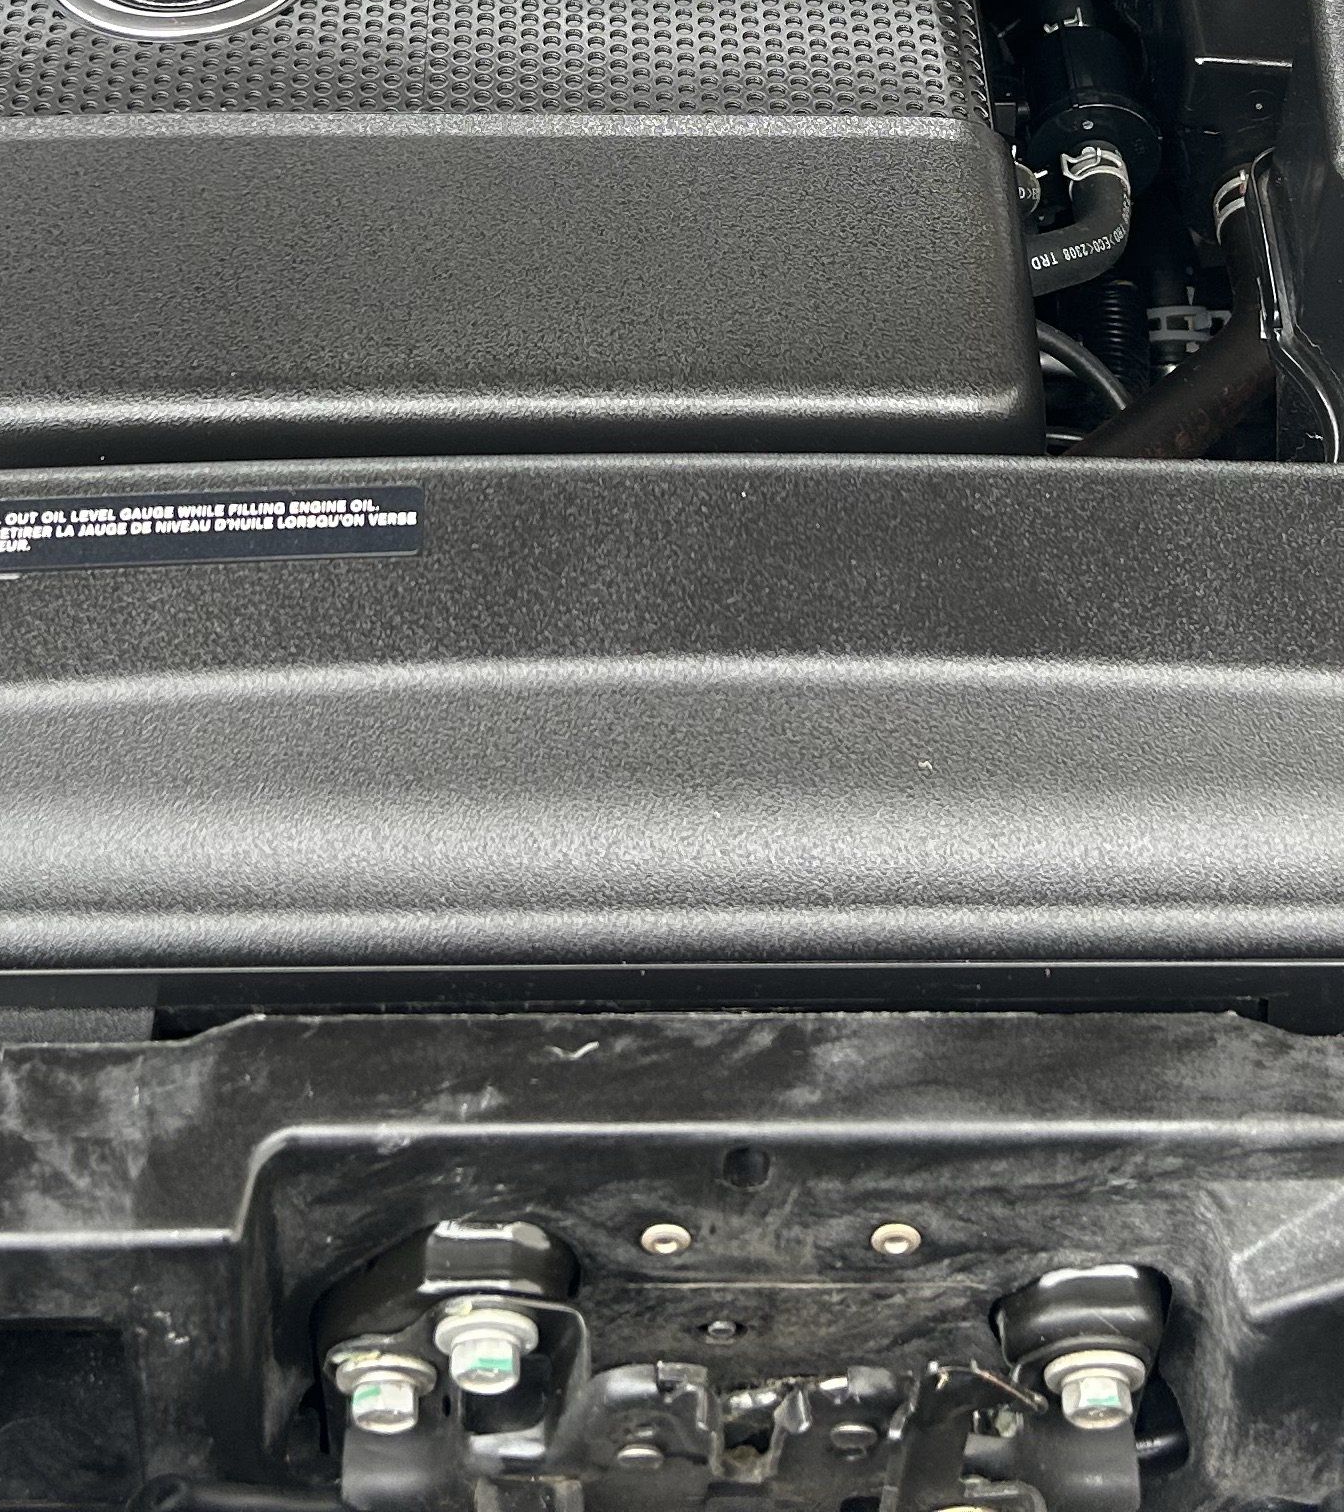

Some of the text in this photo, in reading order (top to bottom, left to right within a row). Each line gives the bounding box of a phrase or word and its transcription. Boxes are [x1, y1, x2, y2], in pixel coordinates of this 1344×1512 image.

[1031, 253, 1059, 271] TRD
[5, 511, 38, 526] OUT
[41, 510, 67, 524] OIL
[71, 508, 116, 523] LEVEL
[119, 505, 174, 521] GAUGE
[178, 504, 225, 519] WHILE
[228, 502, 285, 517] FILLING
[289, 500, 347, 515] ENGINE
[350, 499, 380, 513] OIL.
[55, 524, 75, 538] LA
[78, 522, 128, 537] JAUGE
[131, 521, 152, 535] DE
[155, 518, 211, 534] NIVEAU
[214, 516, 274, 532] D'HUILE
[277, 513, 365, 530] LORSQU'ON
[368, 511, 418, 527] VERSE
